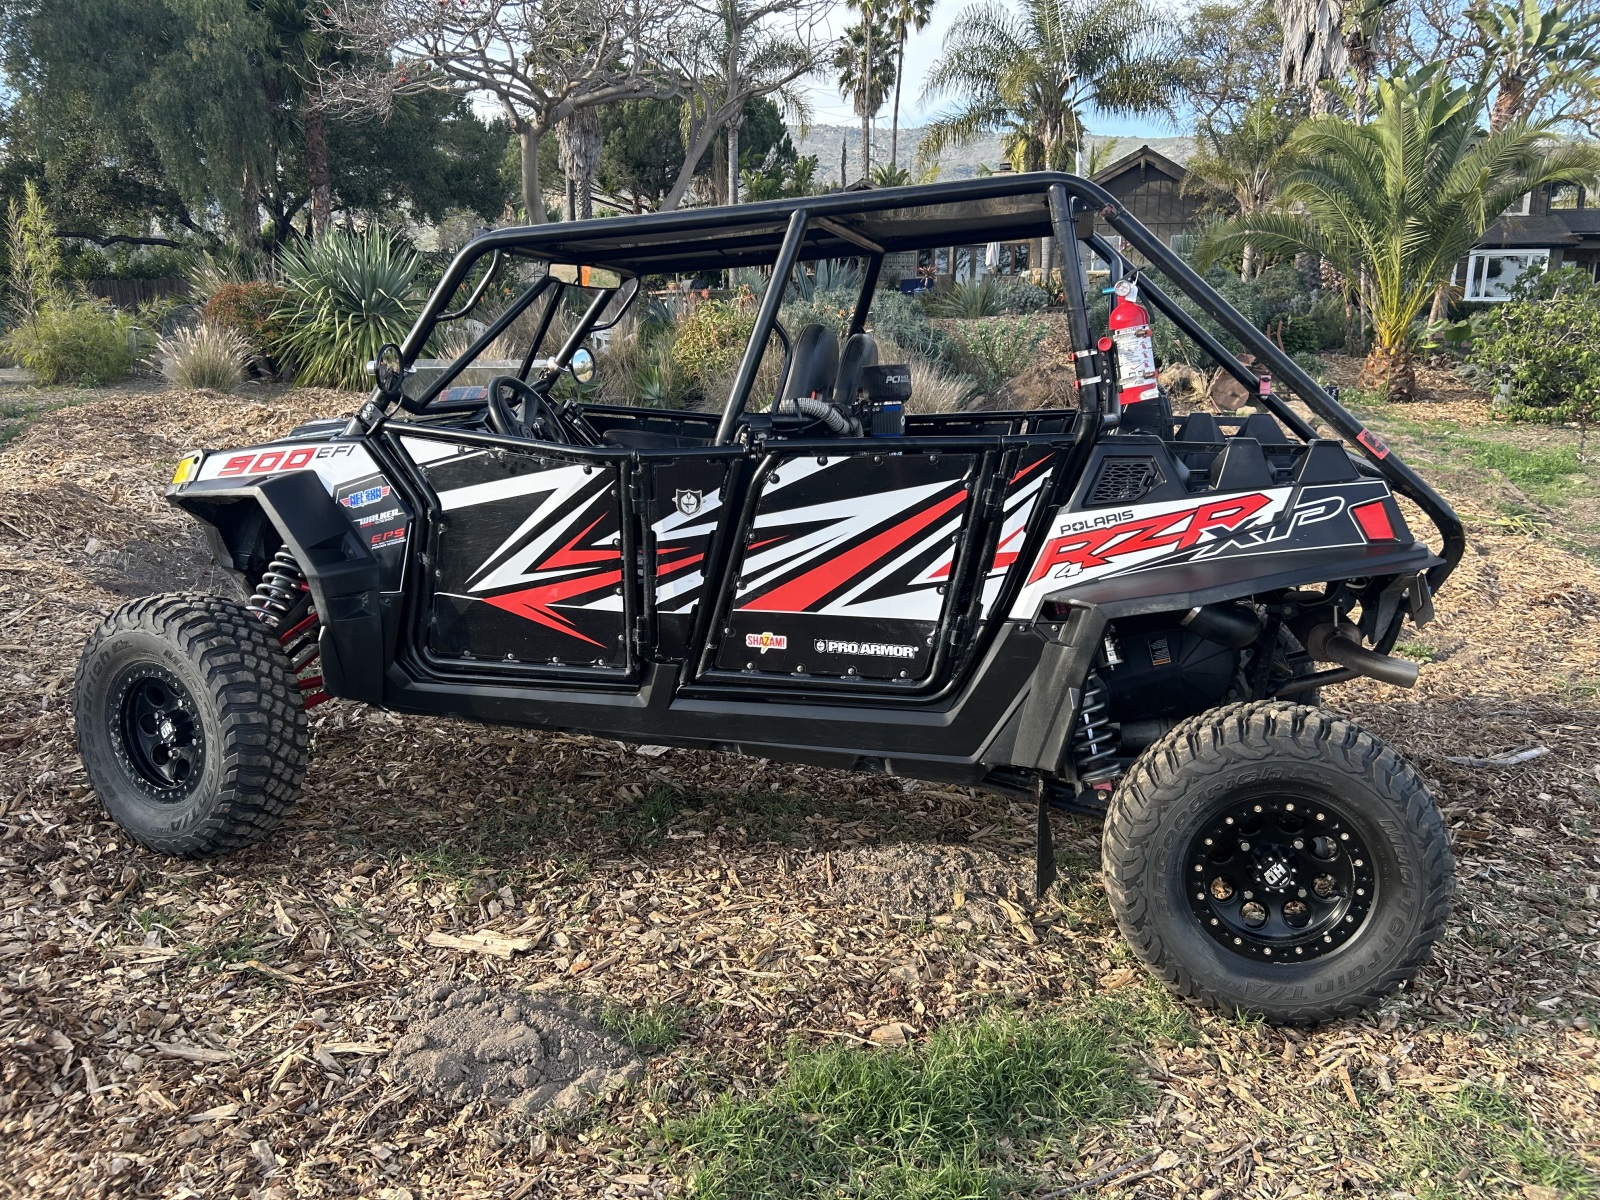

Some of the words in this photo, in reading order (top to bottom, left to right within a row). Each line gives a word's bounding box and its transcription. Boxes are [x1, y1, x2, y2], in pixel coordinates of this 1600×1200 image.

[217, 447, 317, 476] 900
[316, 445, 356, 459] EFI
[359, 508, 399, 525] WALKER
[1060, 510, 1134, 535] POLARIS
[371, 527, 405, 543] EPS
[1025, 492, 1274, 587] RZR
[1055, 562, 1084, 579] 4
[747, 633, 785, 648] SHAZAM!
[828, 641, 859, 654] PRO
[859, 643, 914, 659] ARMOR
[1153, 767, 1284, 917] BFGoodrich
[1314, 820, 1416, 995] Mud-Terrain
[1245, 981, 1307, 1000] T/A
